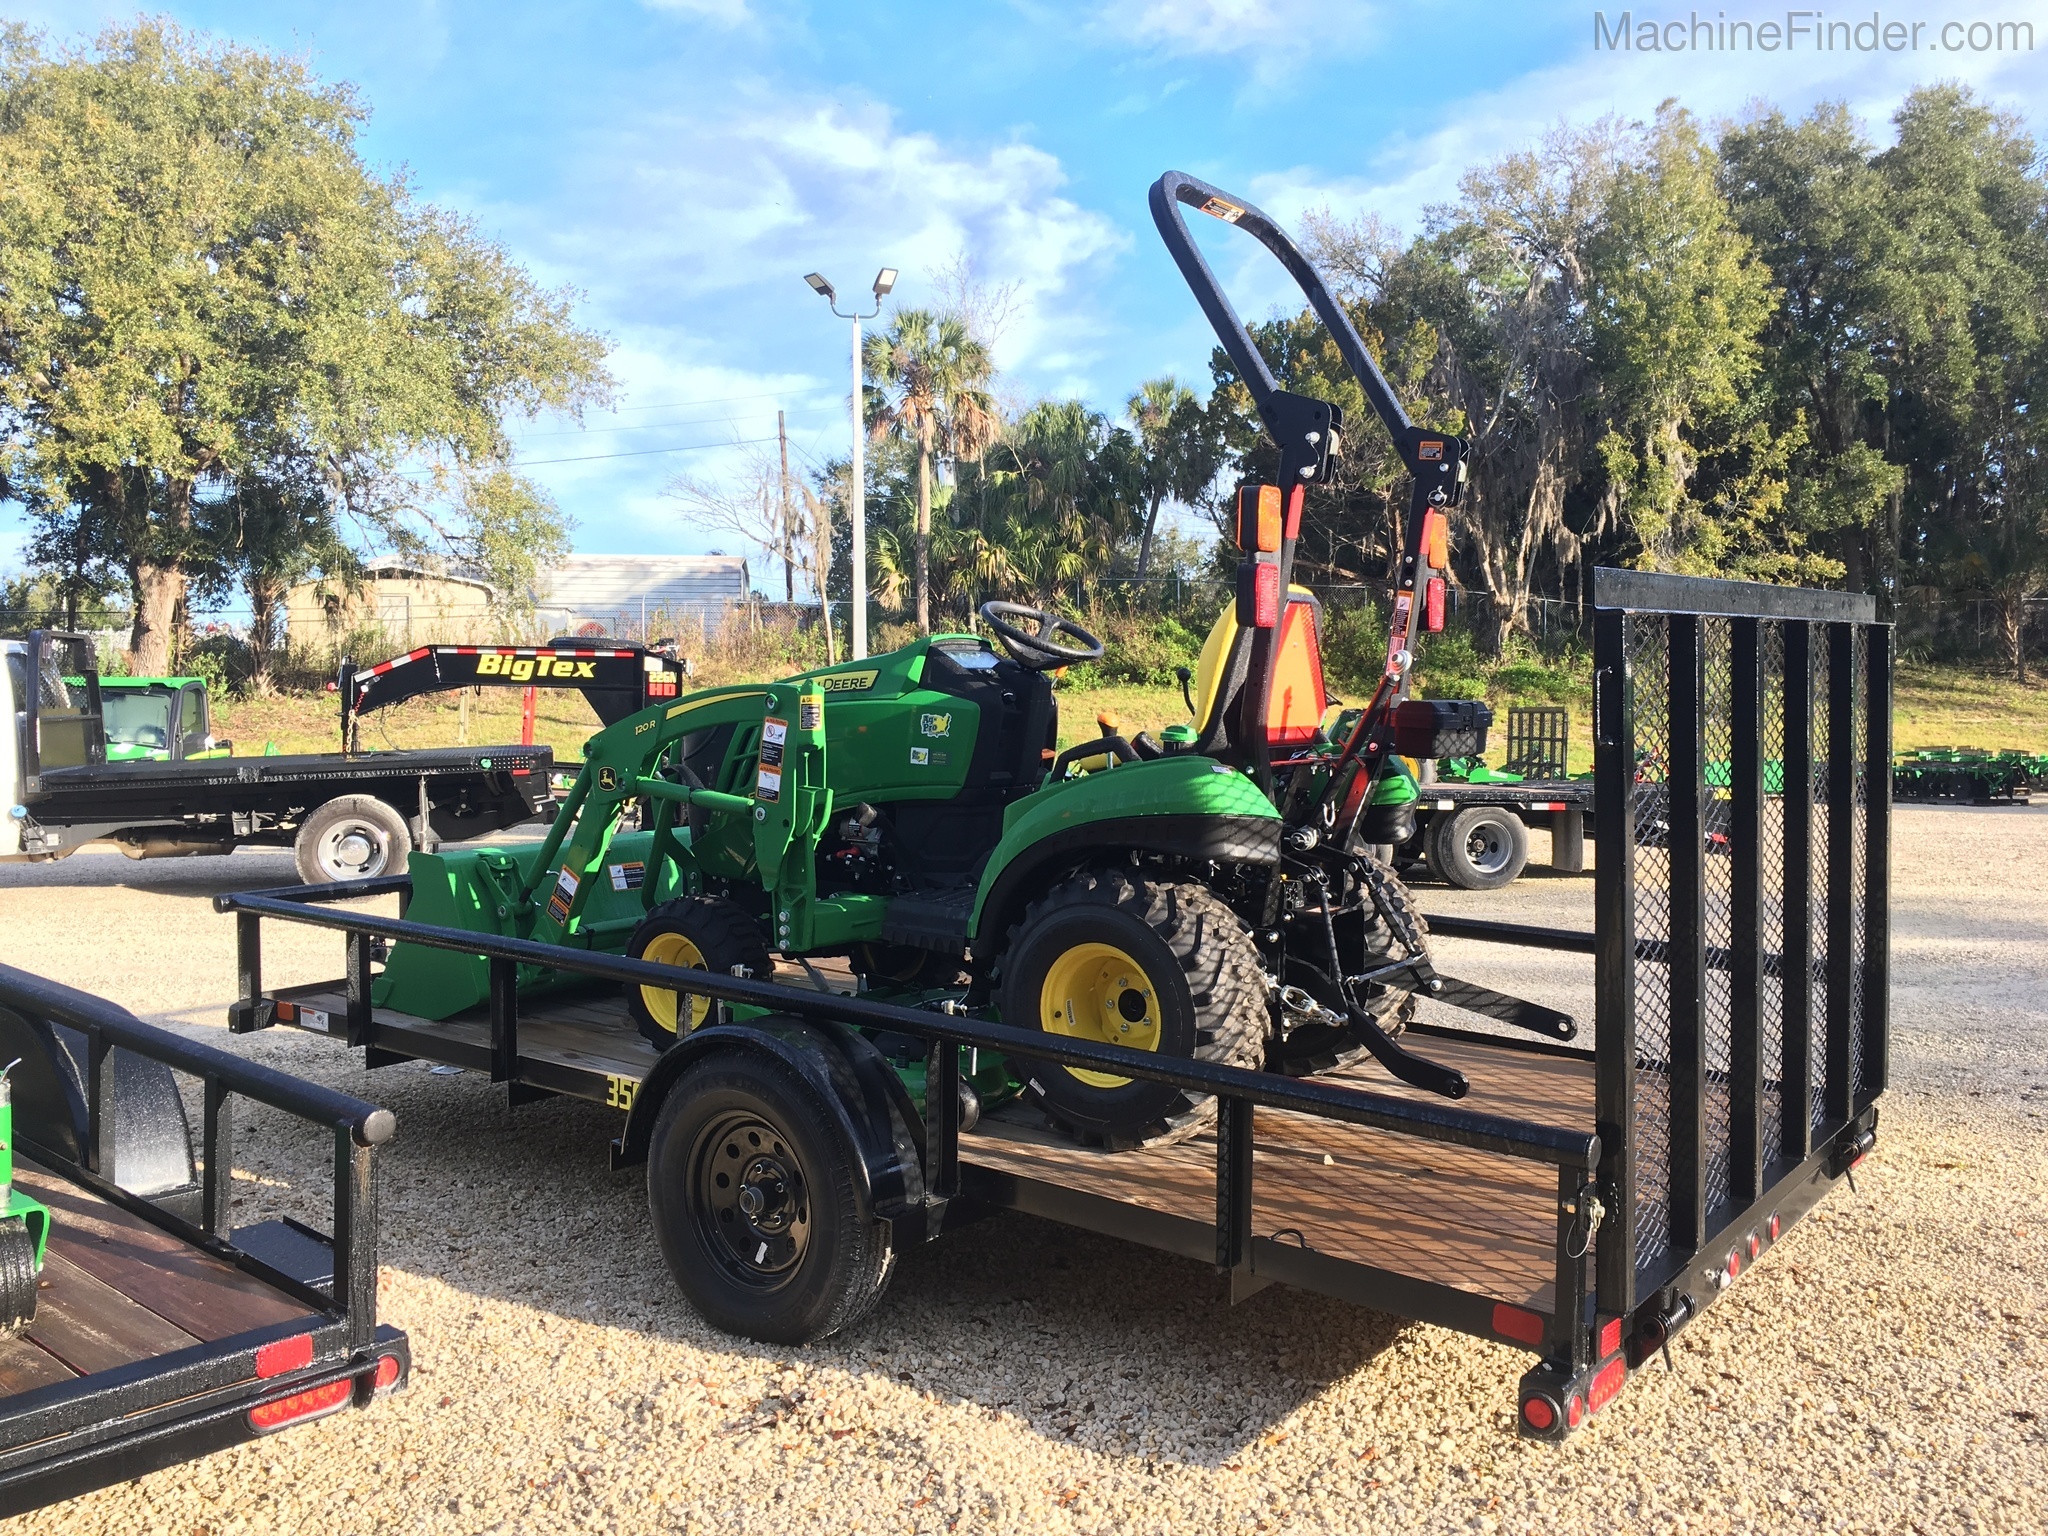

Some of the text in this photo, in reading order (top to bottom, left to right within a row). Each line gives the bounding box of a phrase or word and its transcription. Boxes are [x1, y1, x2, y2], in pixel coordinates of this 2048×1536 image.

[476, 653, 597, 681] BigTex
[649, 683, 676, 696] HD
[824, 677, 868, 691] DEERE
